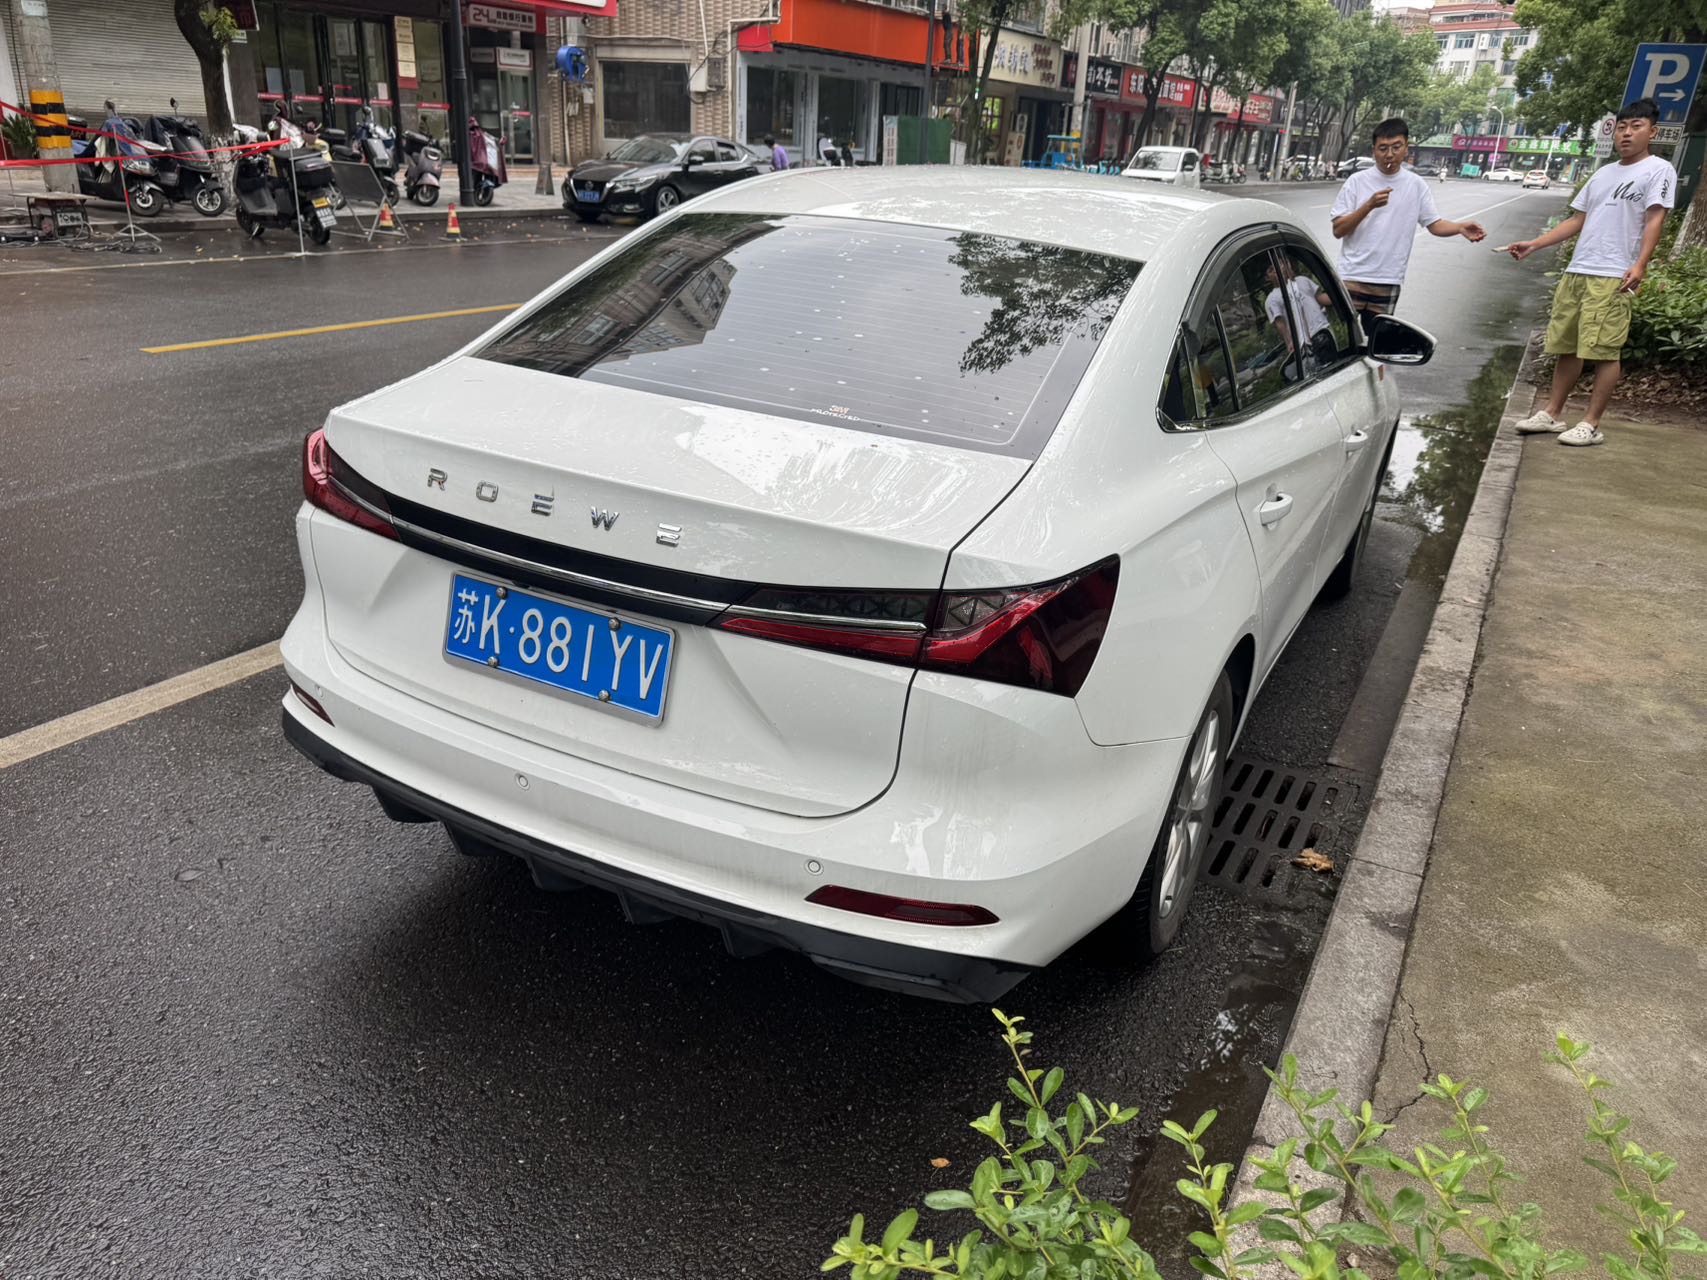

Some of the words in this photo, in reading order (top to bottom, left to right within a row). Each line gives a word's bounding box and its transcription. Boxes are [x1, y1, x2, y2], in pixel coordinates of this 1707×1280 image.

[472, 7, 489, 23] 24
[1641, 53, 1690, 99] P
[427, 467, 683, 548] ROEWE
